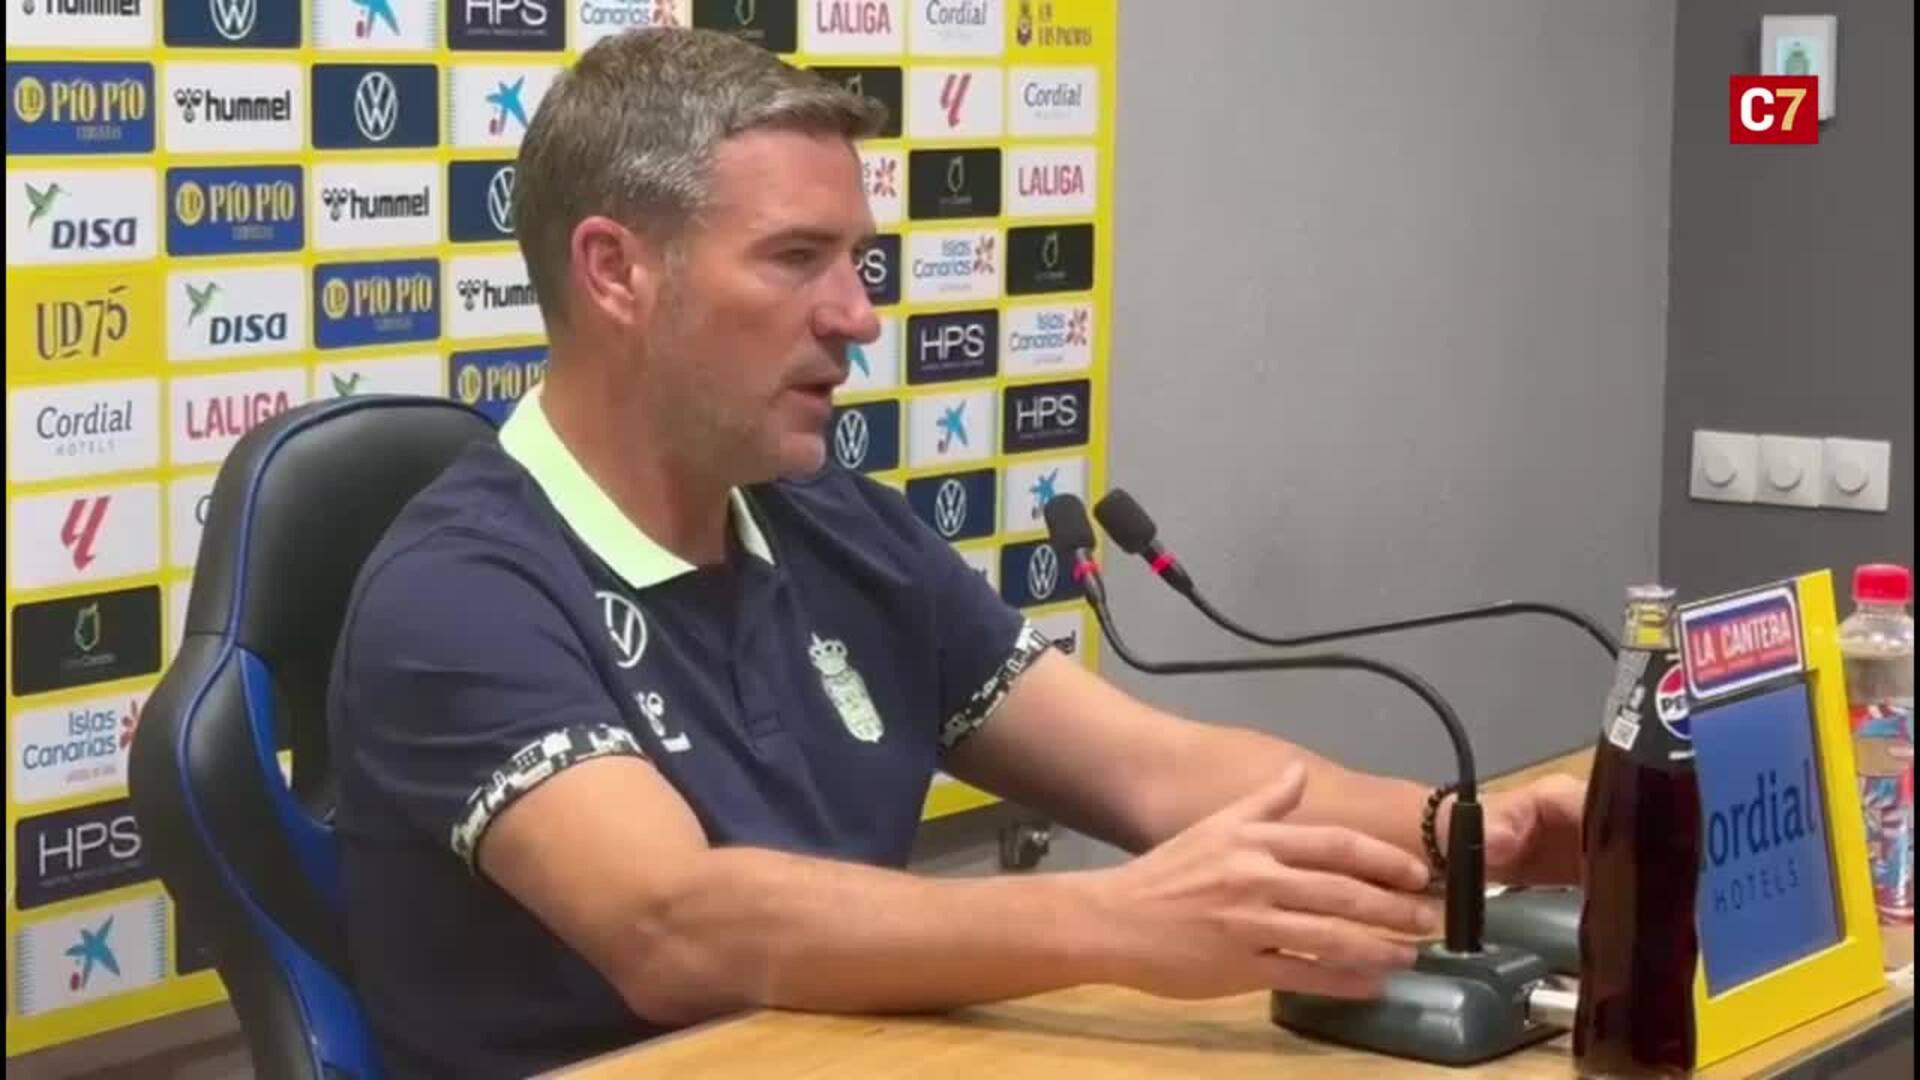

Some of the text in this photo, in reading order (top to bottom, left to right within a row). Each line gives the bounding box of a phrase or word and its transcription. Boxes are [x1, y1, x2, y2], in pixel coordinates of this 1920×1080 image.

[466, 0, 547, 26] HPS
[816, 0, 891, 34] LALIGA
[926, 0, 988, 26] Cordial
[205, 90, 290, 122] hummel
[1024, 82, 1082, 107] Cordial
[1018, 165, 1084, 195] LALIGA
[350, 187, 429, 219] hummel
[920, 324, 985, 361] HPS
[37, 401, 132, 440] Cordial
[1016, 395, 1077, 431] HPS
[1720, 608, 1794, 660] CANTERA
[68, 709, 117, 737] Islas
[23, 735, 117, 770] Canarias
[1701, 758, 1817, 871] ordial
[38, 815, 142, 877] HPS
[1714, 858, 1801, 913] HOTELS
